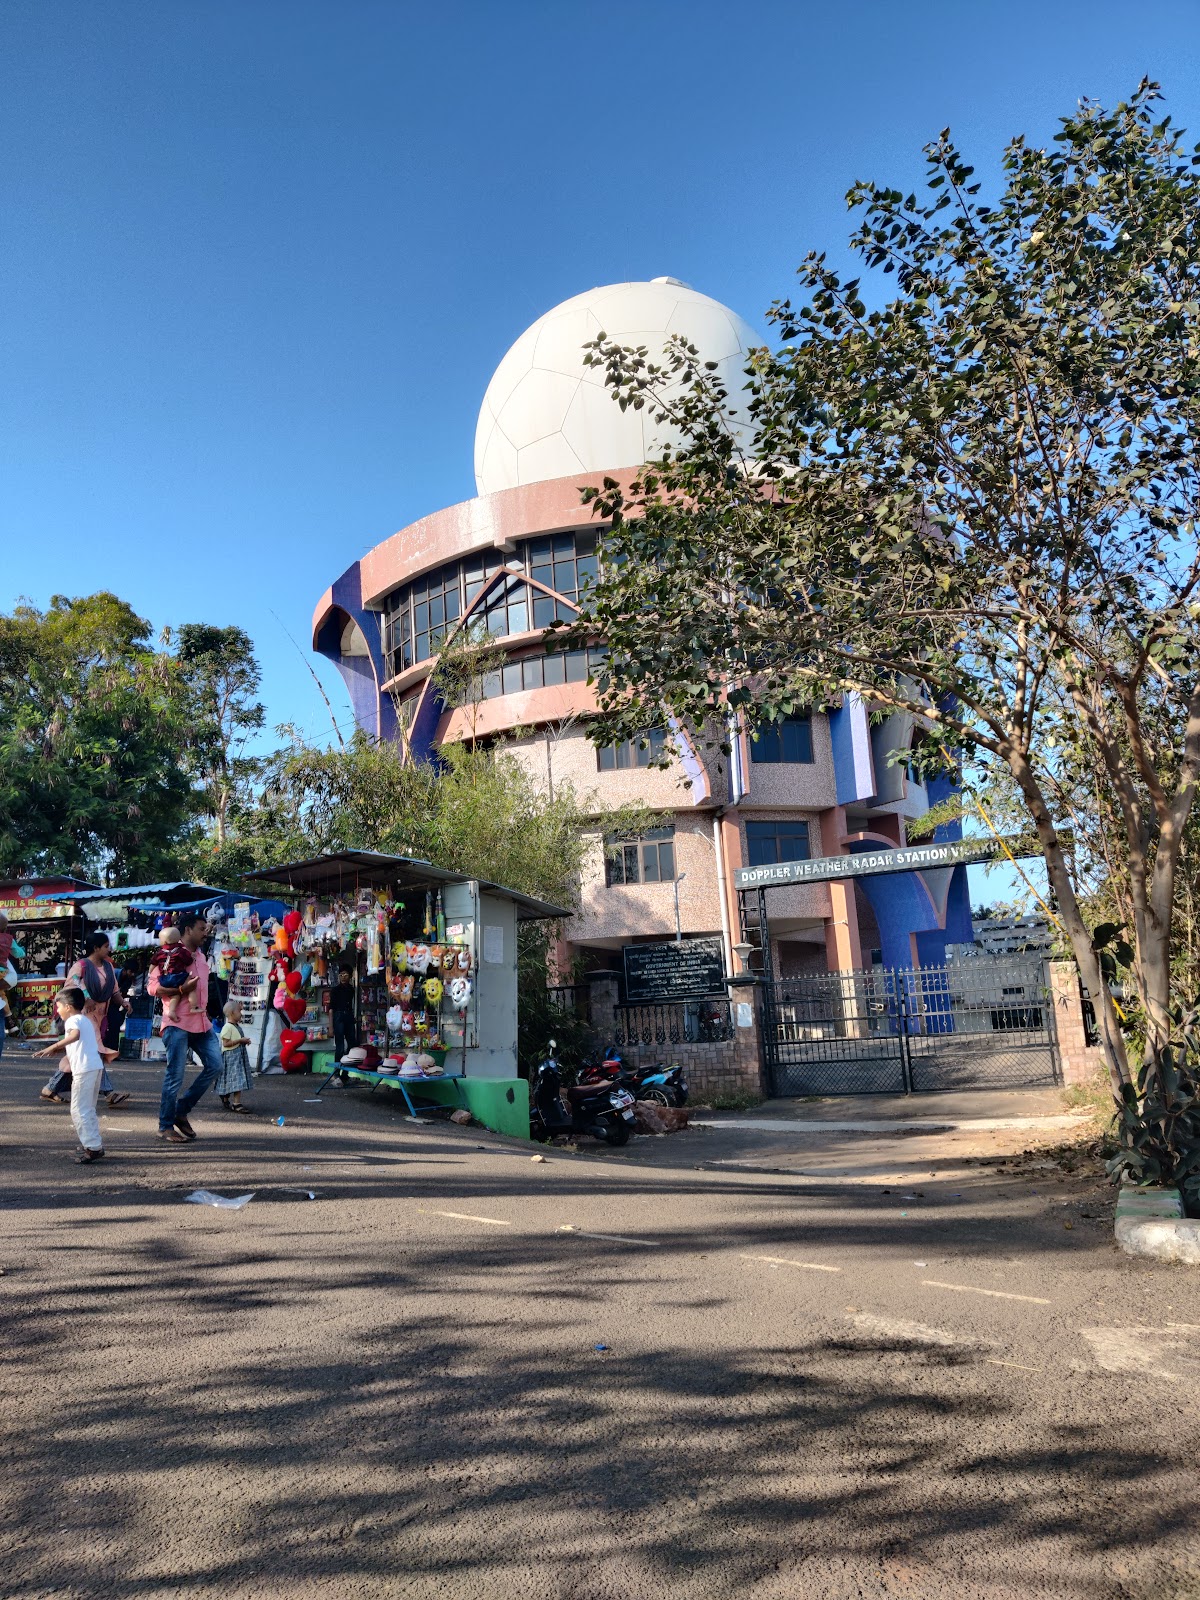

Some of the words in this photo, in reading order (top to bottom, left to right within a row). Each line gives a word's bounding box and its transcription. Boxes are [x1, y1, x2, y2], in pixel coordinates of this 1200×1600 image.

[741, 867, 791, 881] DOPPLER
[794, 861, 849, 875] WEATHER
[852, 855, 894, 869] RADAR
[896, 847, 948, 864] STATION
[27, 898, 49, 906] BHEL
